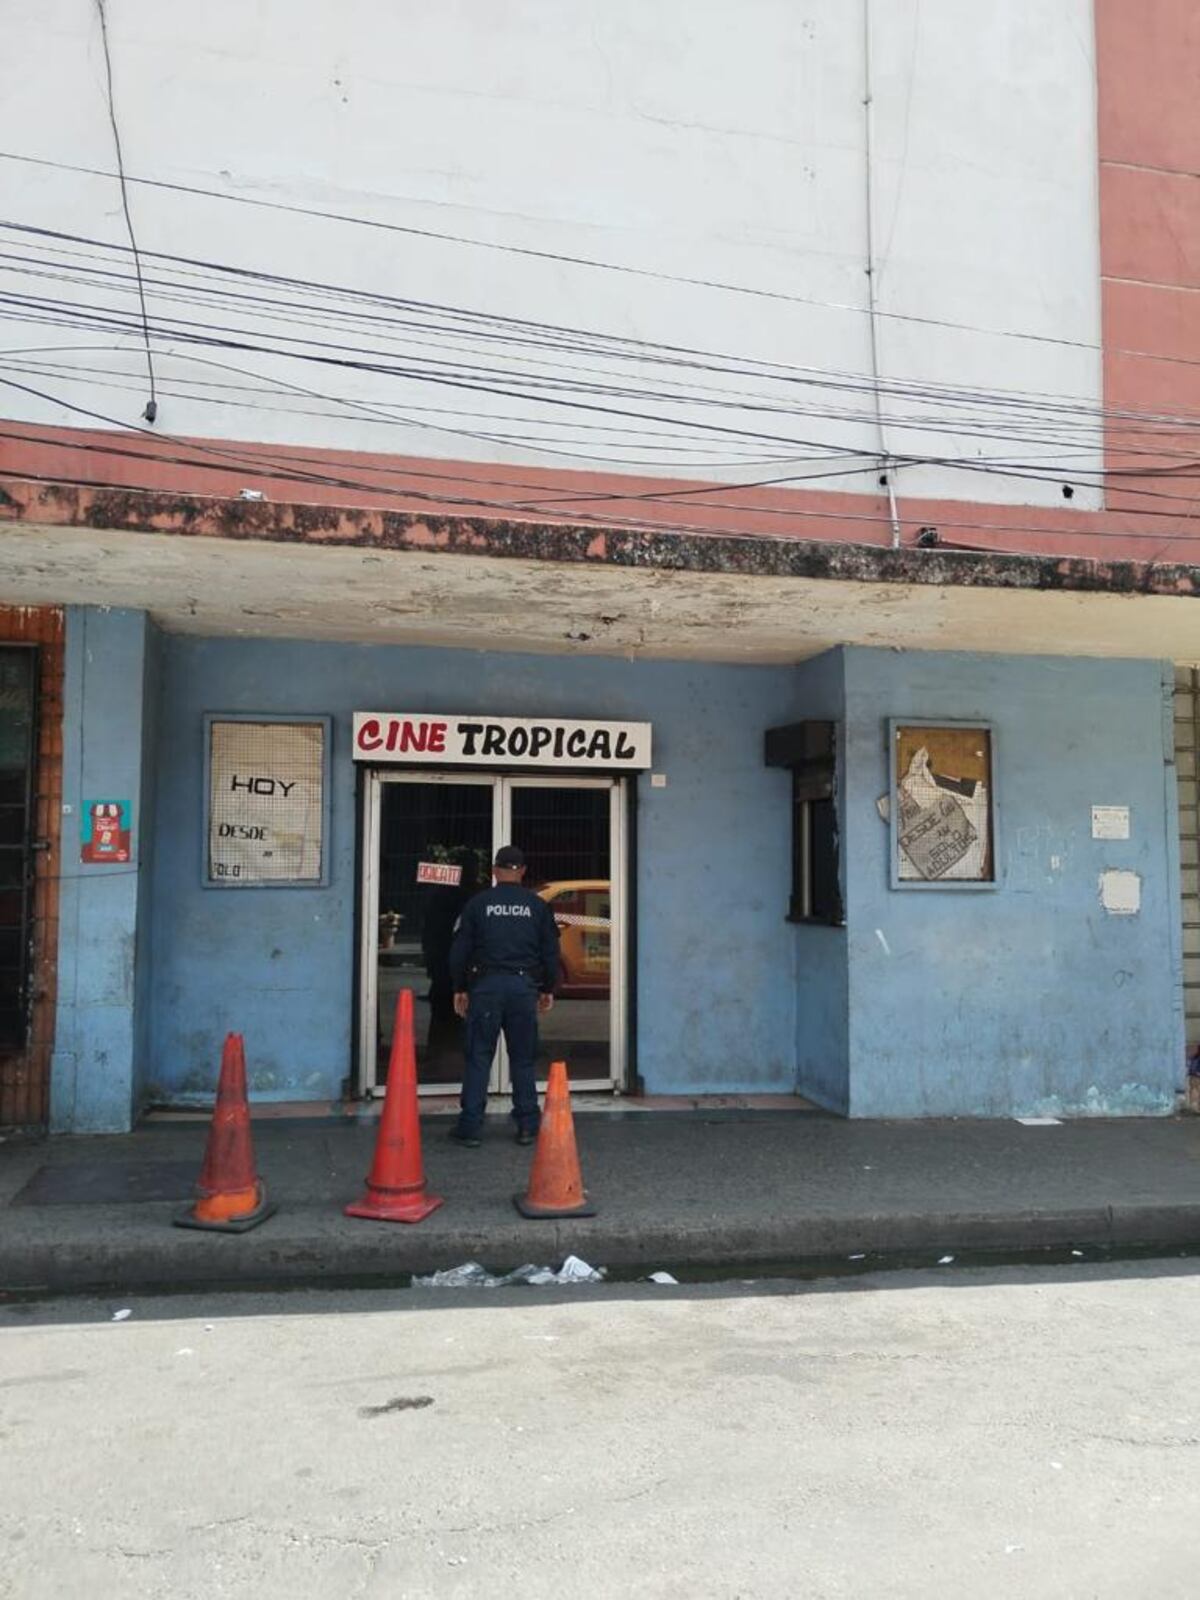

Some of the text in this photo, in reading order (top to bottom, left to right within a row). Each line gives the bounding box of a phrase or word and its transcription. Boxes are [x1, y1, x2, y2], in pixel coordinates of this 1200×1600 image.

[357, 720, 637, 760] CINE TROPICAL
[231, 775, 297, 798] HOY
[218, 823, 269, 841] DESDE
